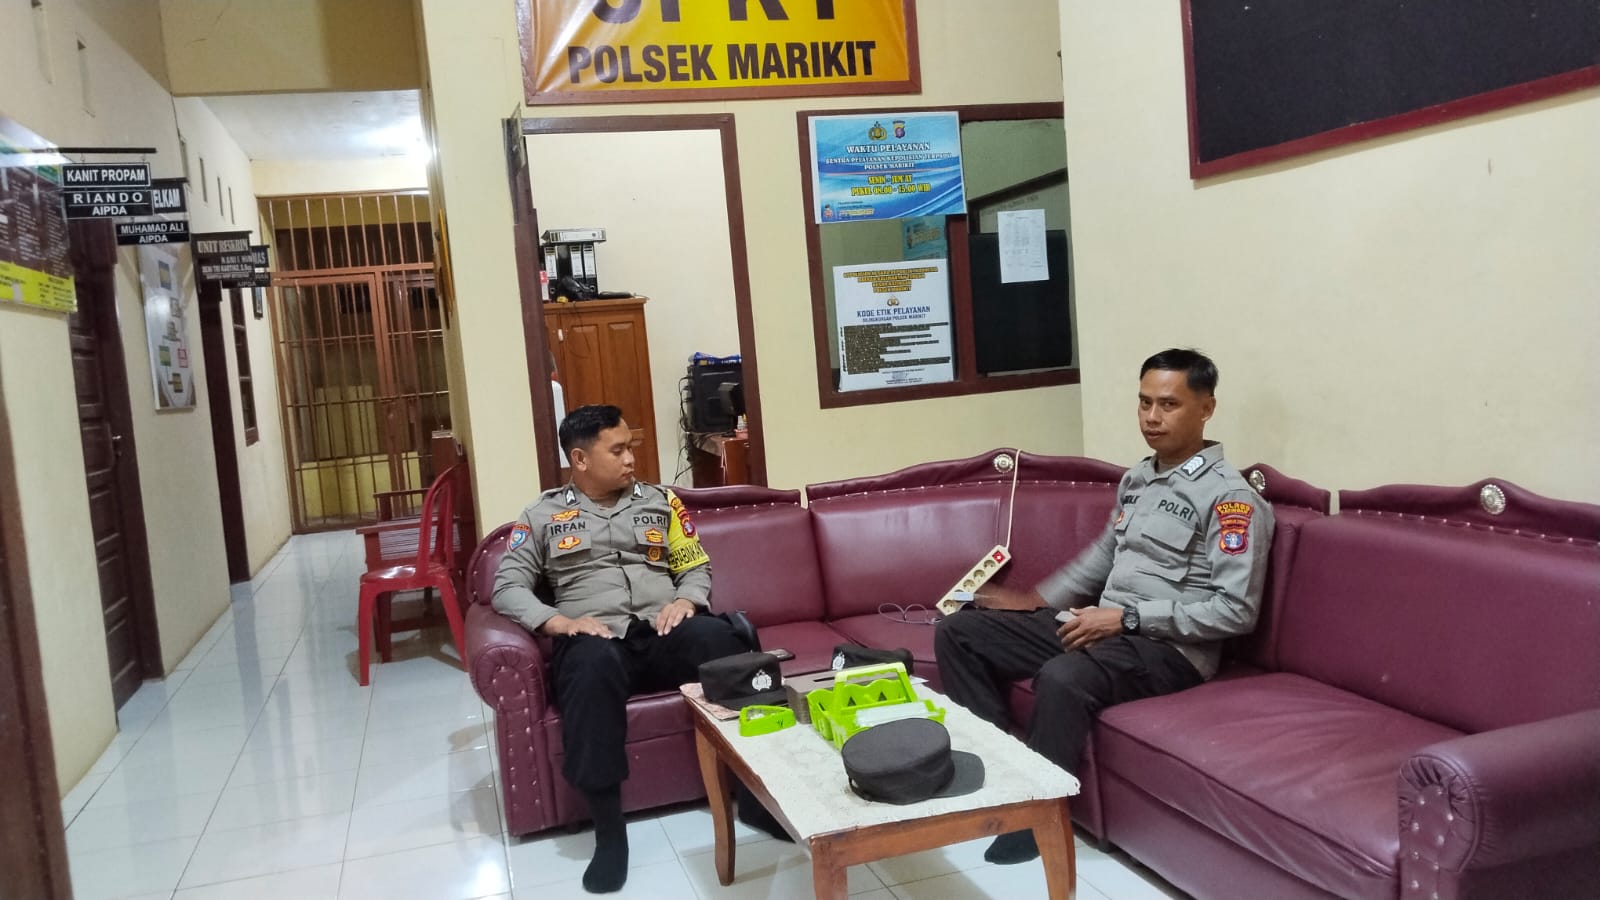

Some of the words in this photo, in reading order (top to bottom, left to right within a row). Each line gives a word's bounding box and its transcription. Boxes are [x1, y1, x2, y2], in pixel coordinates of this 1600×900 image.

[568, 44, 716, 84] POLSEK
[727, 40, 876, 80] MARIKIT
[847, 145, 878, 154] WAKTU
[880, 142, 930, 152] PELAYANAN
[66, 169, 99, 182] KANIT
[101, 169, 146, 182] PROPAM
[73, 192, 143, 204] RIANDO
[92, 205, 128, 216] AIPDA
[121, 223, 168, 234] MUHAMAD
[169, 222, 184, 232] ALI
[139, 234, 169, 243] AIPDA
[857, 309, 875, 318] KODE
[876, 308, 892, 316] ETIK
[893, 306, 931, 315] PELAYANAN
[1157, 499, 1194, 521] POLRI
[633, 516, 666, 525] POLRI
[551, 521, 586, 536] IRFAN
